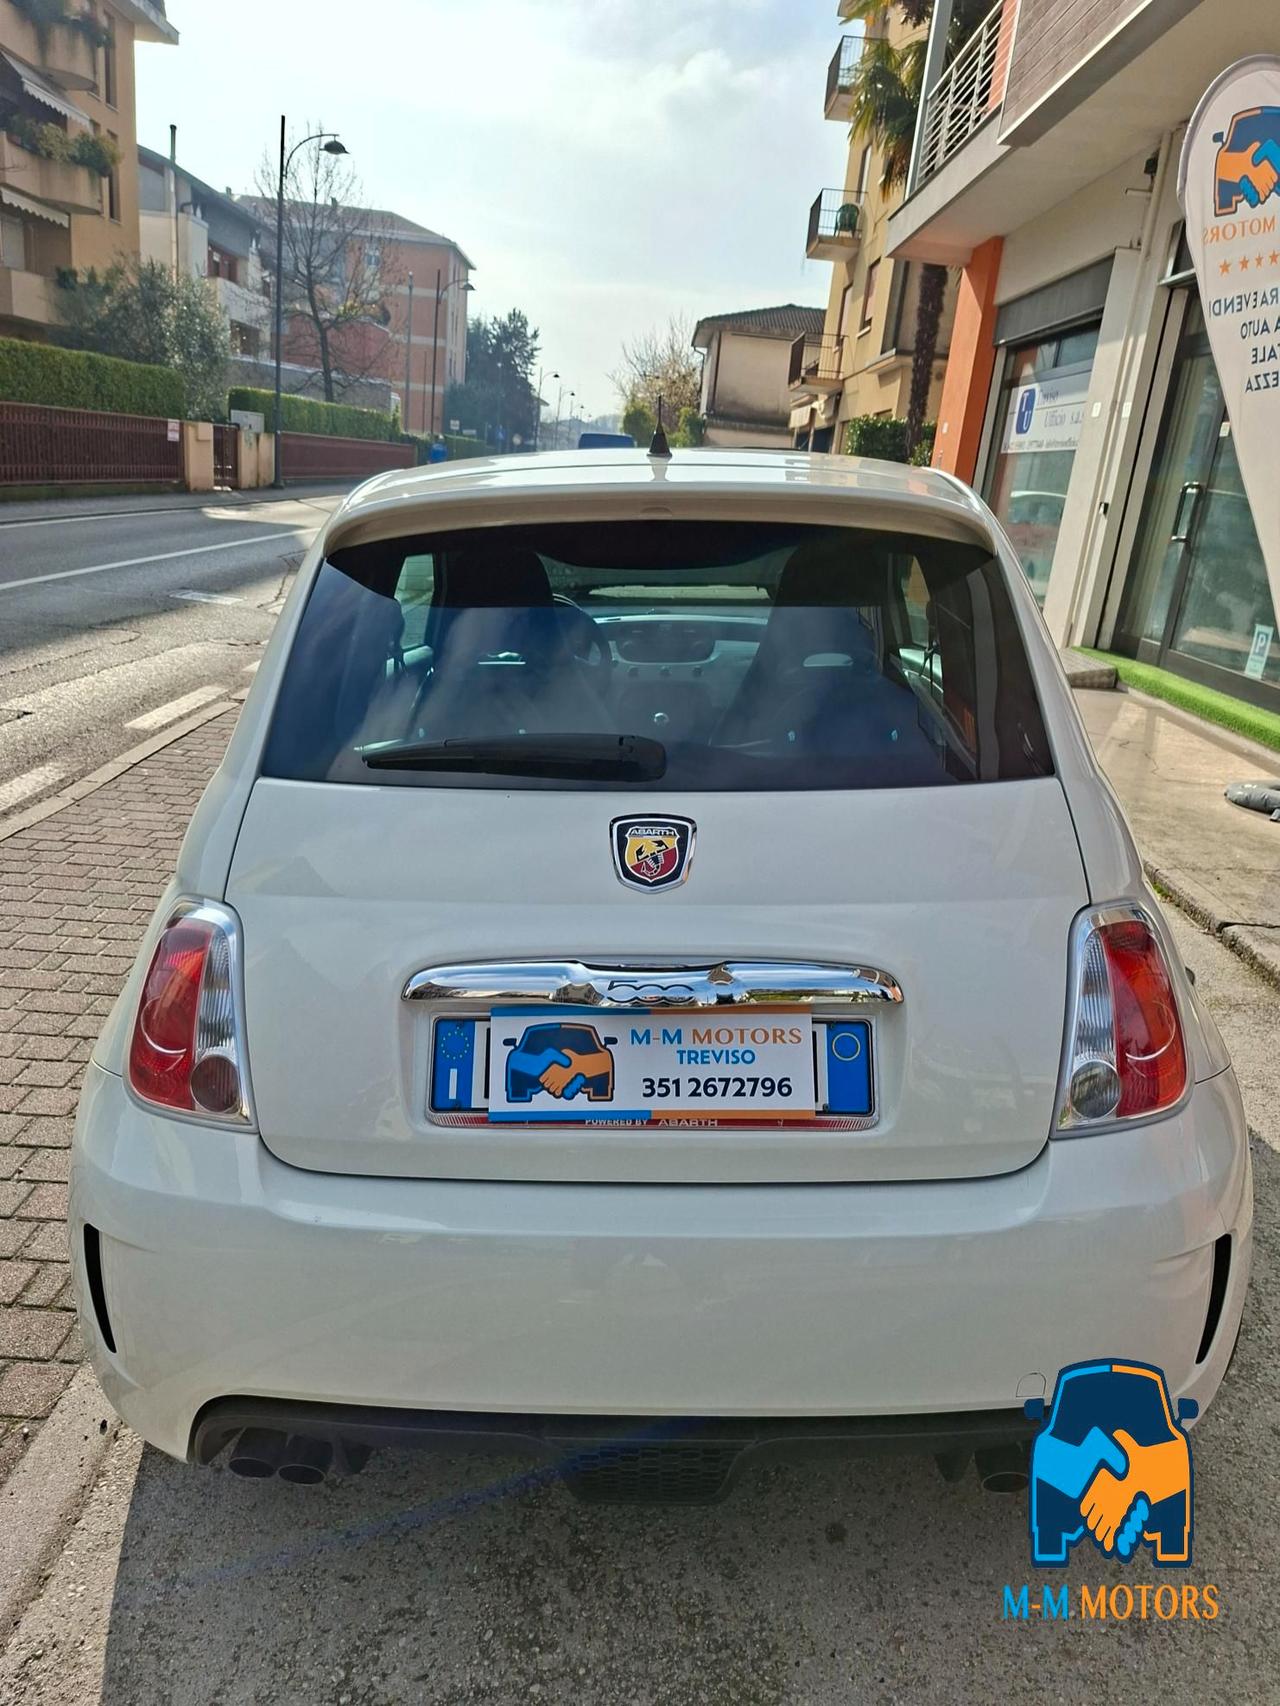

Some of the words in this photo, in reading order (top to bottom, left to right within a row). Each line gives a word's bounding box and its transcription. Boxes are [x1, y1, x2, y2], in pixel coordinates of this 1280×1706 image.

[631, 828, 675, 836] ABARTH
[607, 980, 695, 1004] 500
[630, 1028, 682, 1046] M-M
[692, 1027, 803, 1045] MOTORS
[676, 1048, 756, 1066] TREVISO
[641, 1077, 681, 1098] 351
[687, 1076, 793, 1098] 2672796
[658, 1118, 719, 1127] ABARTH
